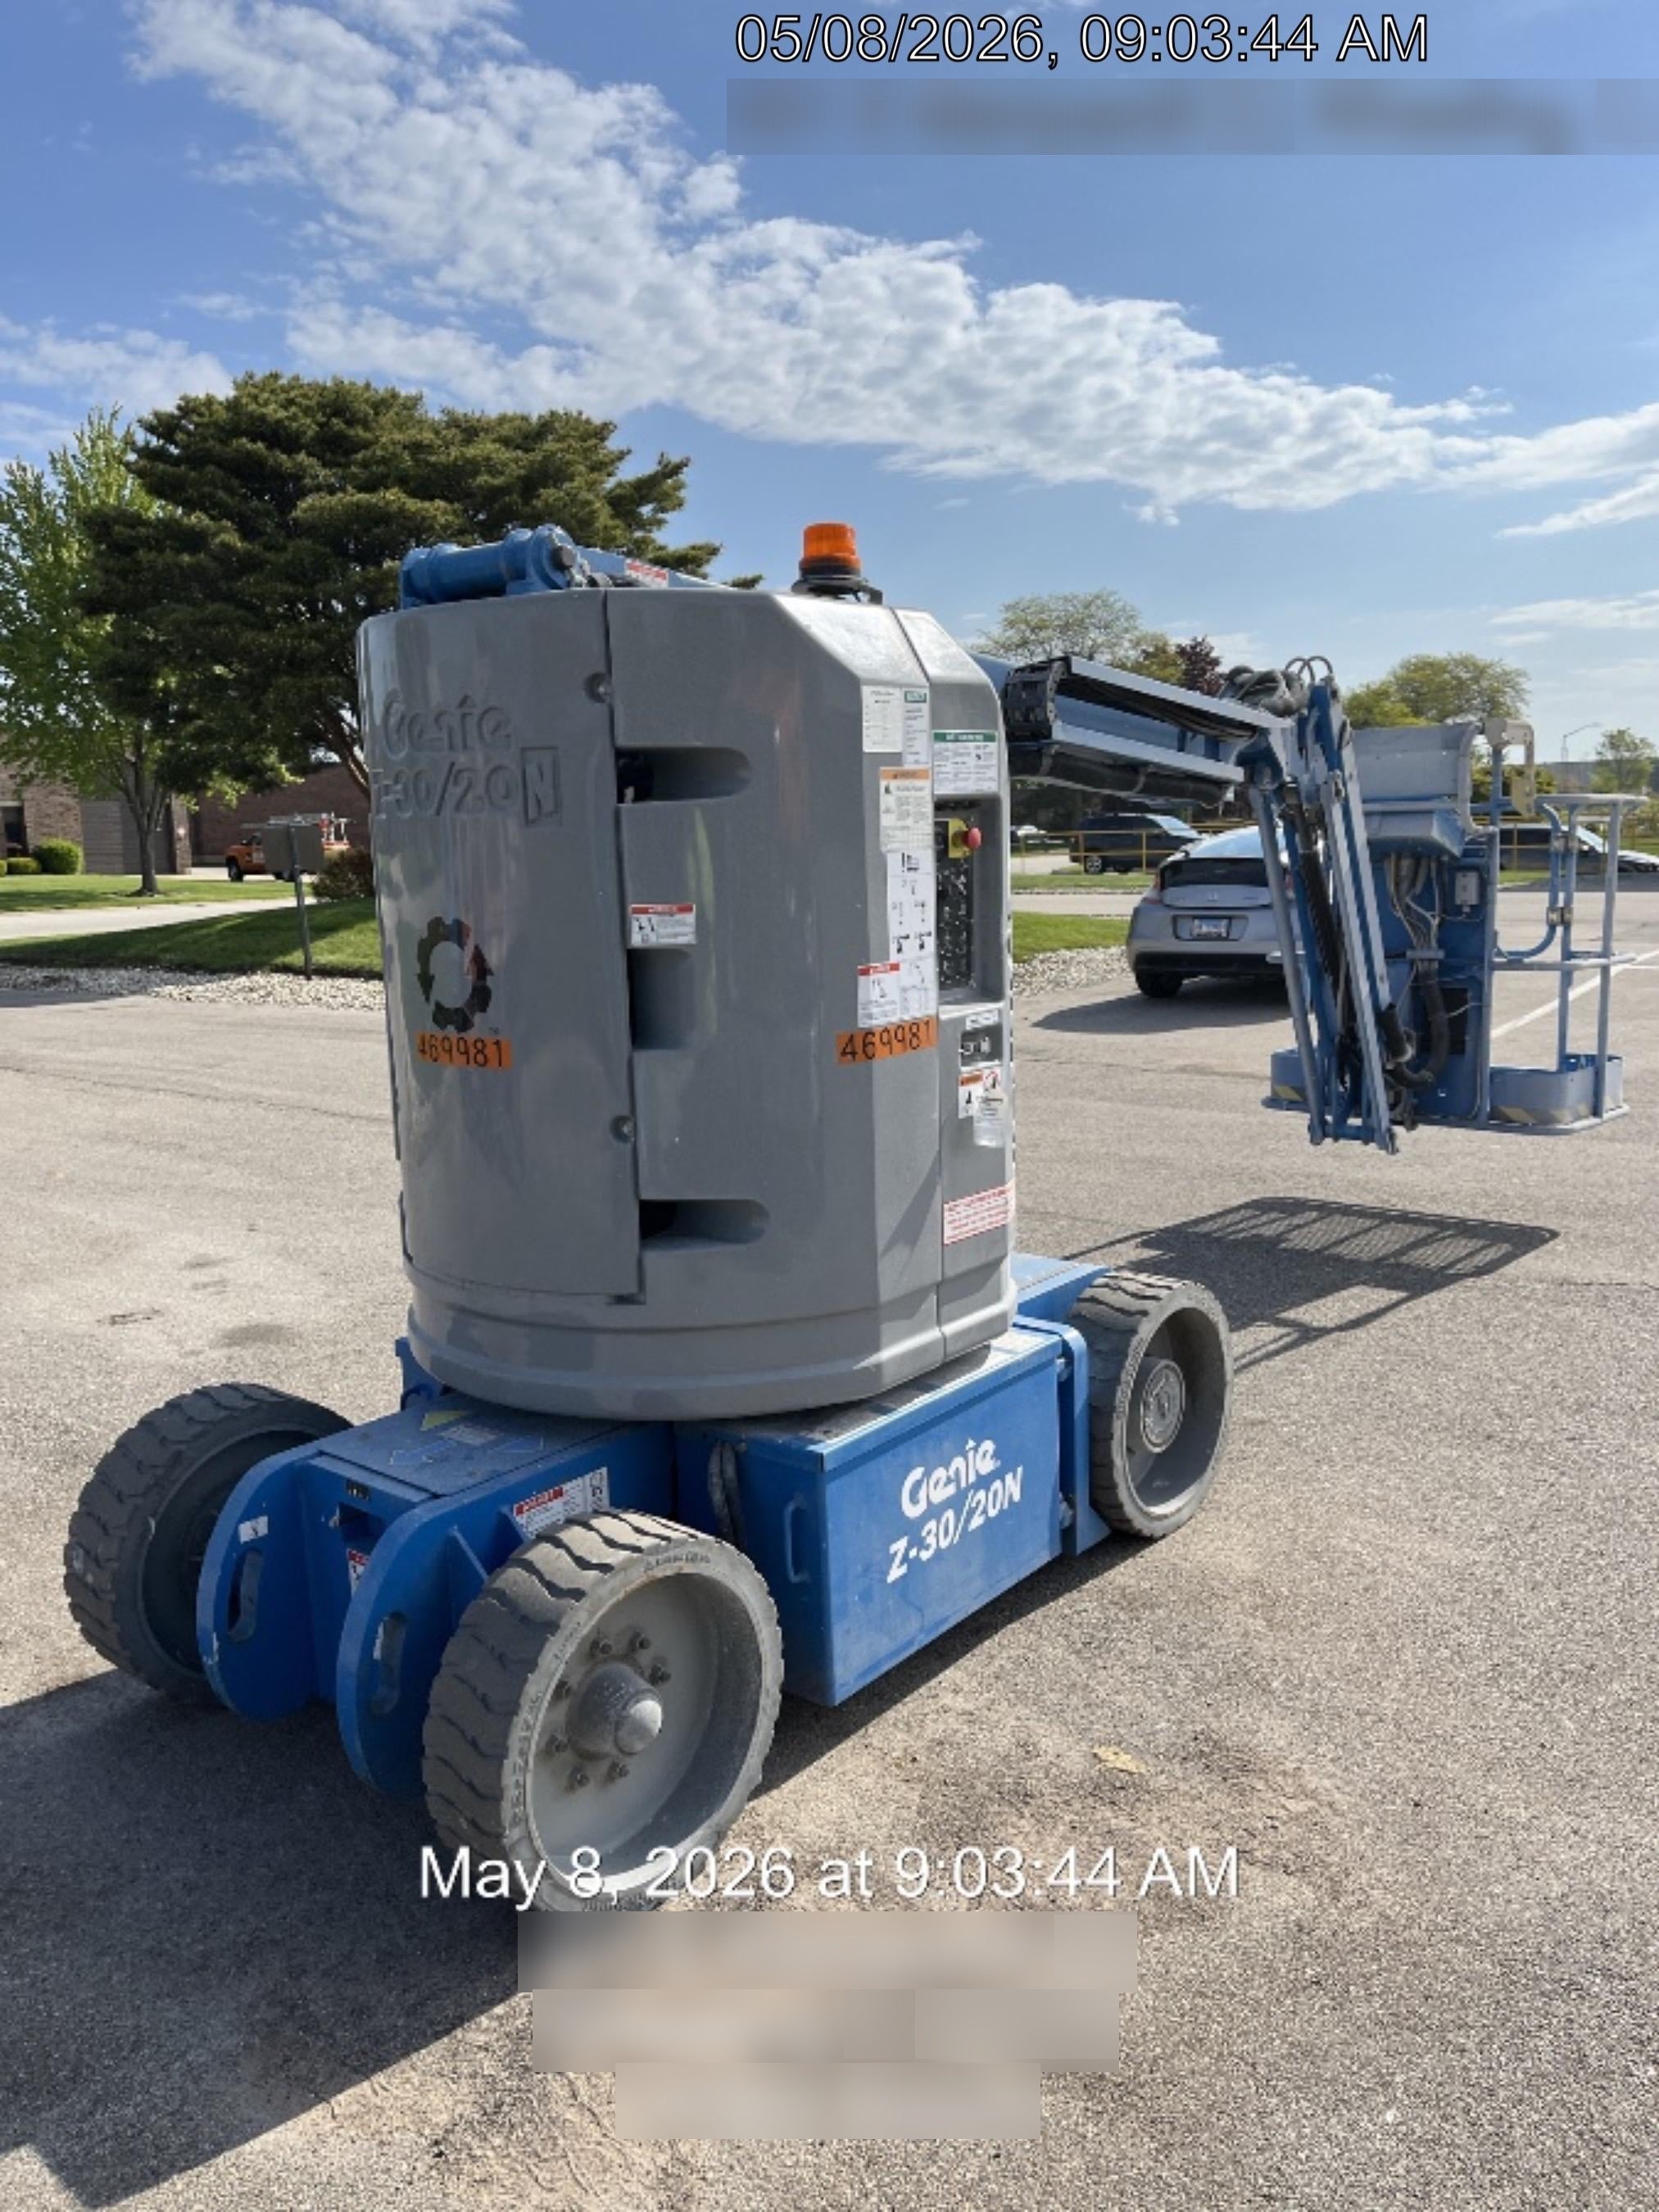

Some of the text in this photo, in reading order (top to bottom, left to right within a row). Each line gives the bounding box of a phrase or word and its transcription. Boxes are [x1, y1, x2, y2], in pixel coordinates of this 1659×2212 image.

[383, 688, 512, 760] Genie
[418, 1034, 503, 1067] 469981
[840, 1020, 931, 1062] 469981
[901, 1438, 1002, 1520] Genie
[886, 1464, 1024, 1584] Z-30/20N
